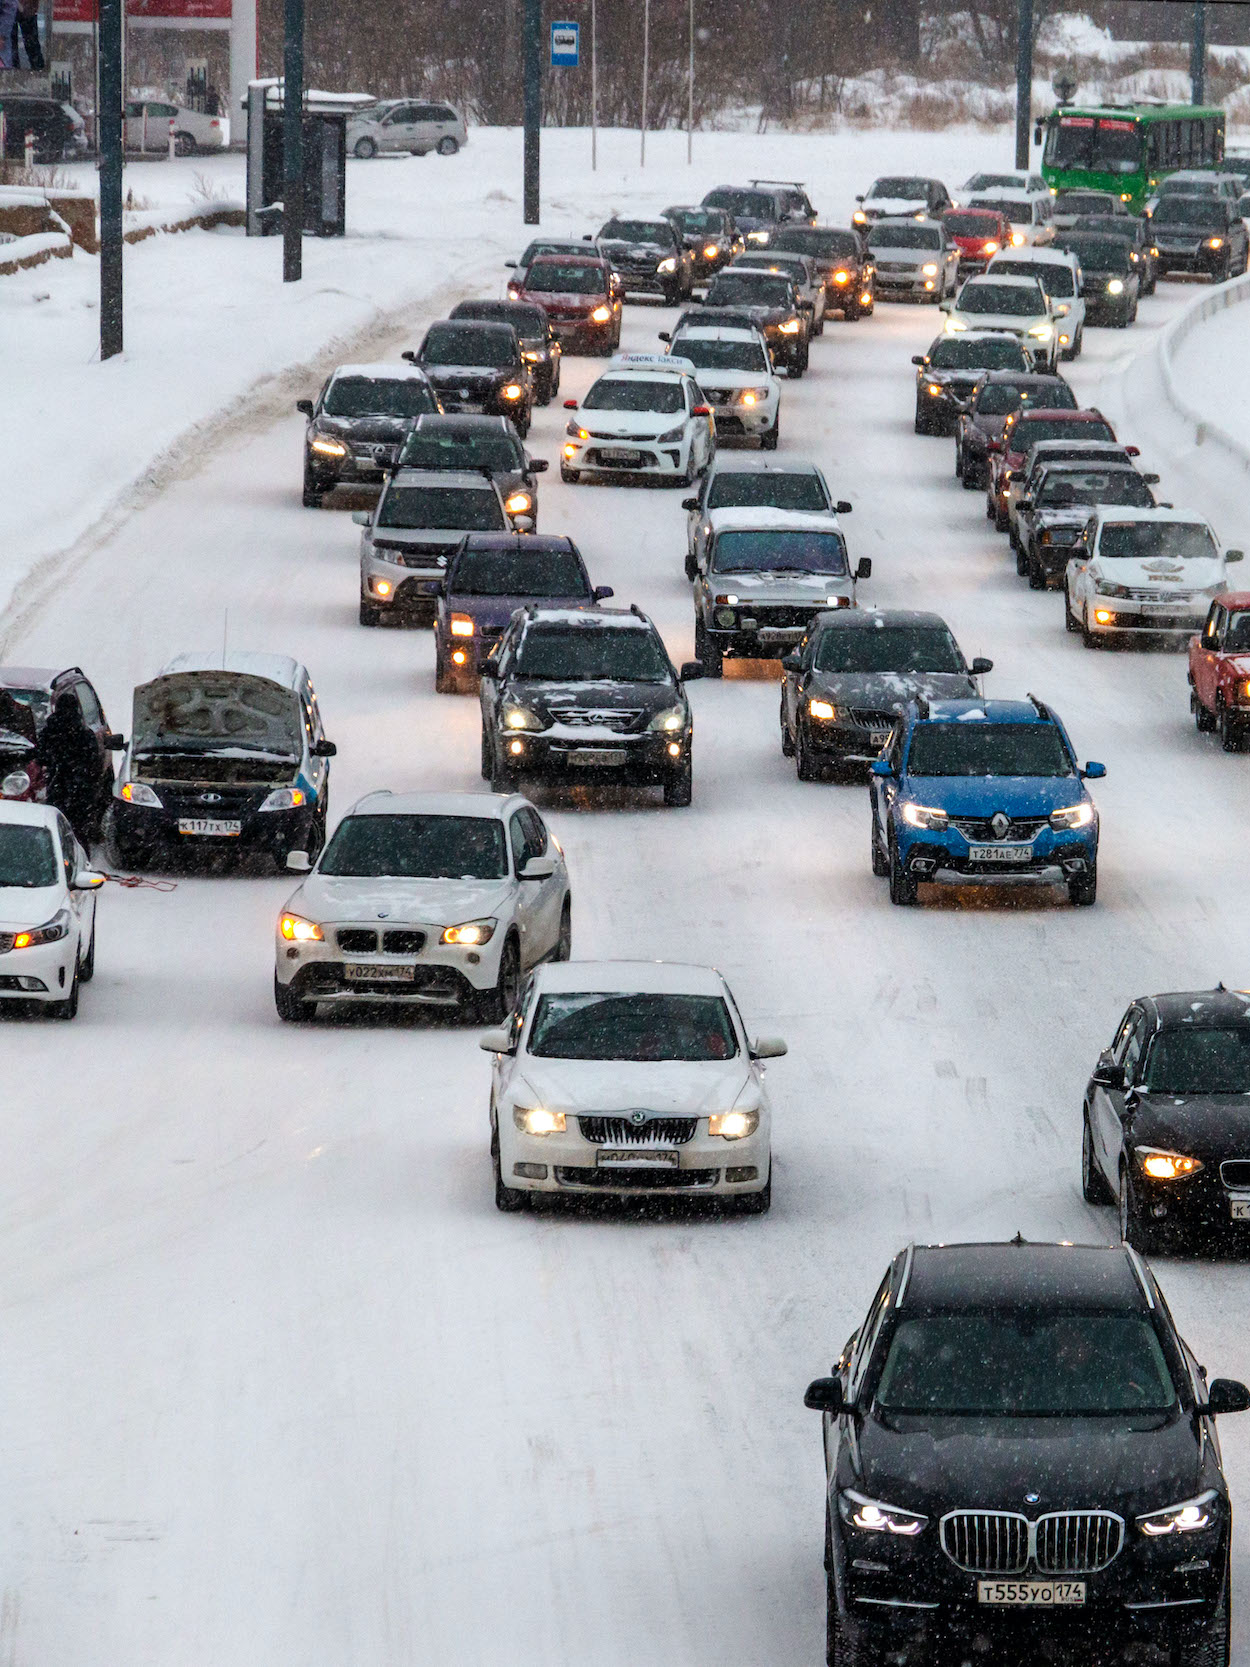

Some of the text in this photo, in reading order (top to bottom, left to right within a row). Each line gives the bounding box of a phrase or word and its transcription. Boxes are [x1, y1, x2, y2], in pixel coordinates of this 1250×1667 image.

[180, 820, 221, 831] К117ТХ
[973, 848, 1012, 859] Т281АЕ
[983, 1584, 1081, 1601] Т555УО 174
